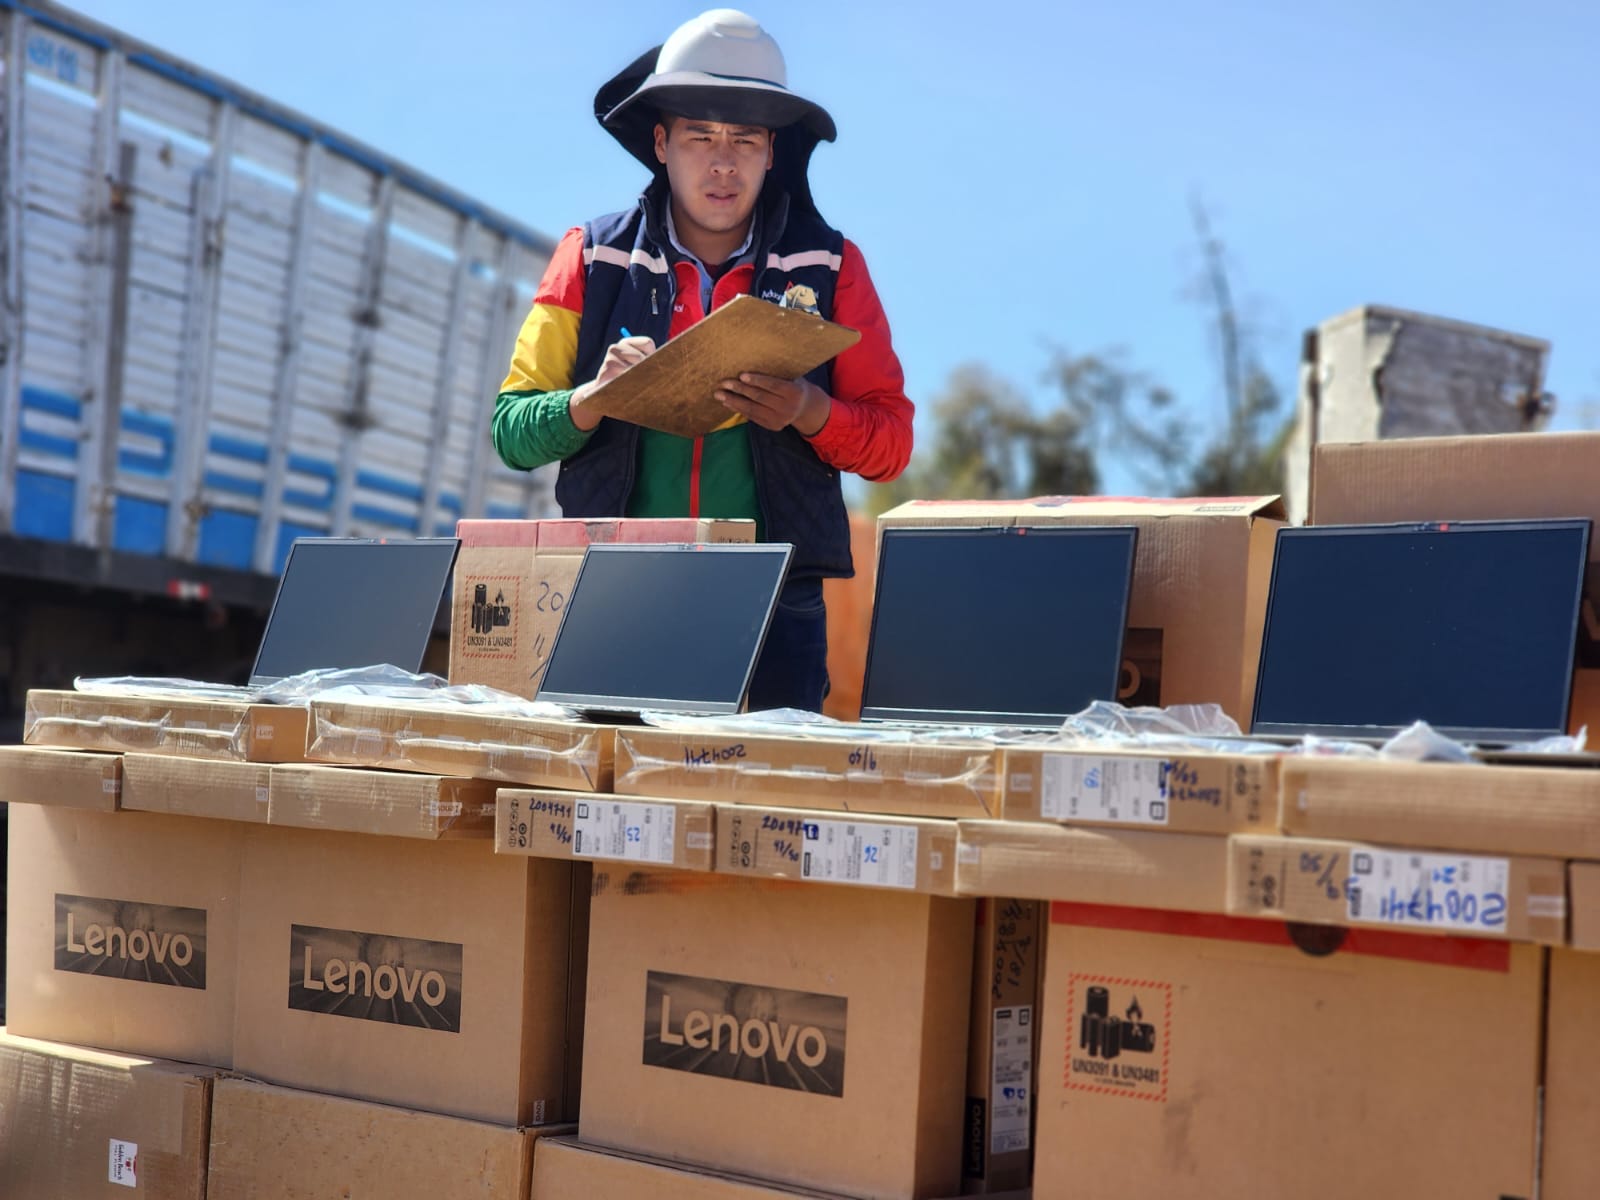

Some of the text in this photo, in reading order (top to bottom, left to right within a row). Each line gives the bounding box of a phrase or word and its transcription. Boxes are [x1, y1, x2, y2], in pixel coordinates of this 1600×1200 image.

[537, 581, 566, 612] 20
[1379, 888, 1506, 927] 2004741
[66, 912, 194, 967] Lenovo
[303, 945, 447, 1008] Lenovo
[659, 994, 828, 1068] Lenovo
[1112, 1063, 1120, 1078] &
